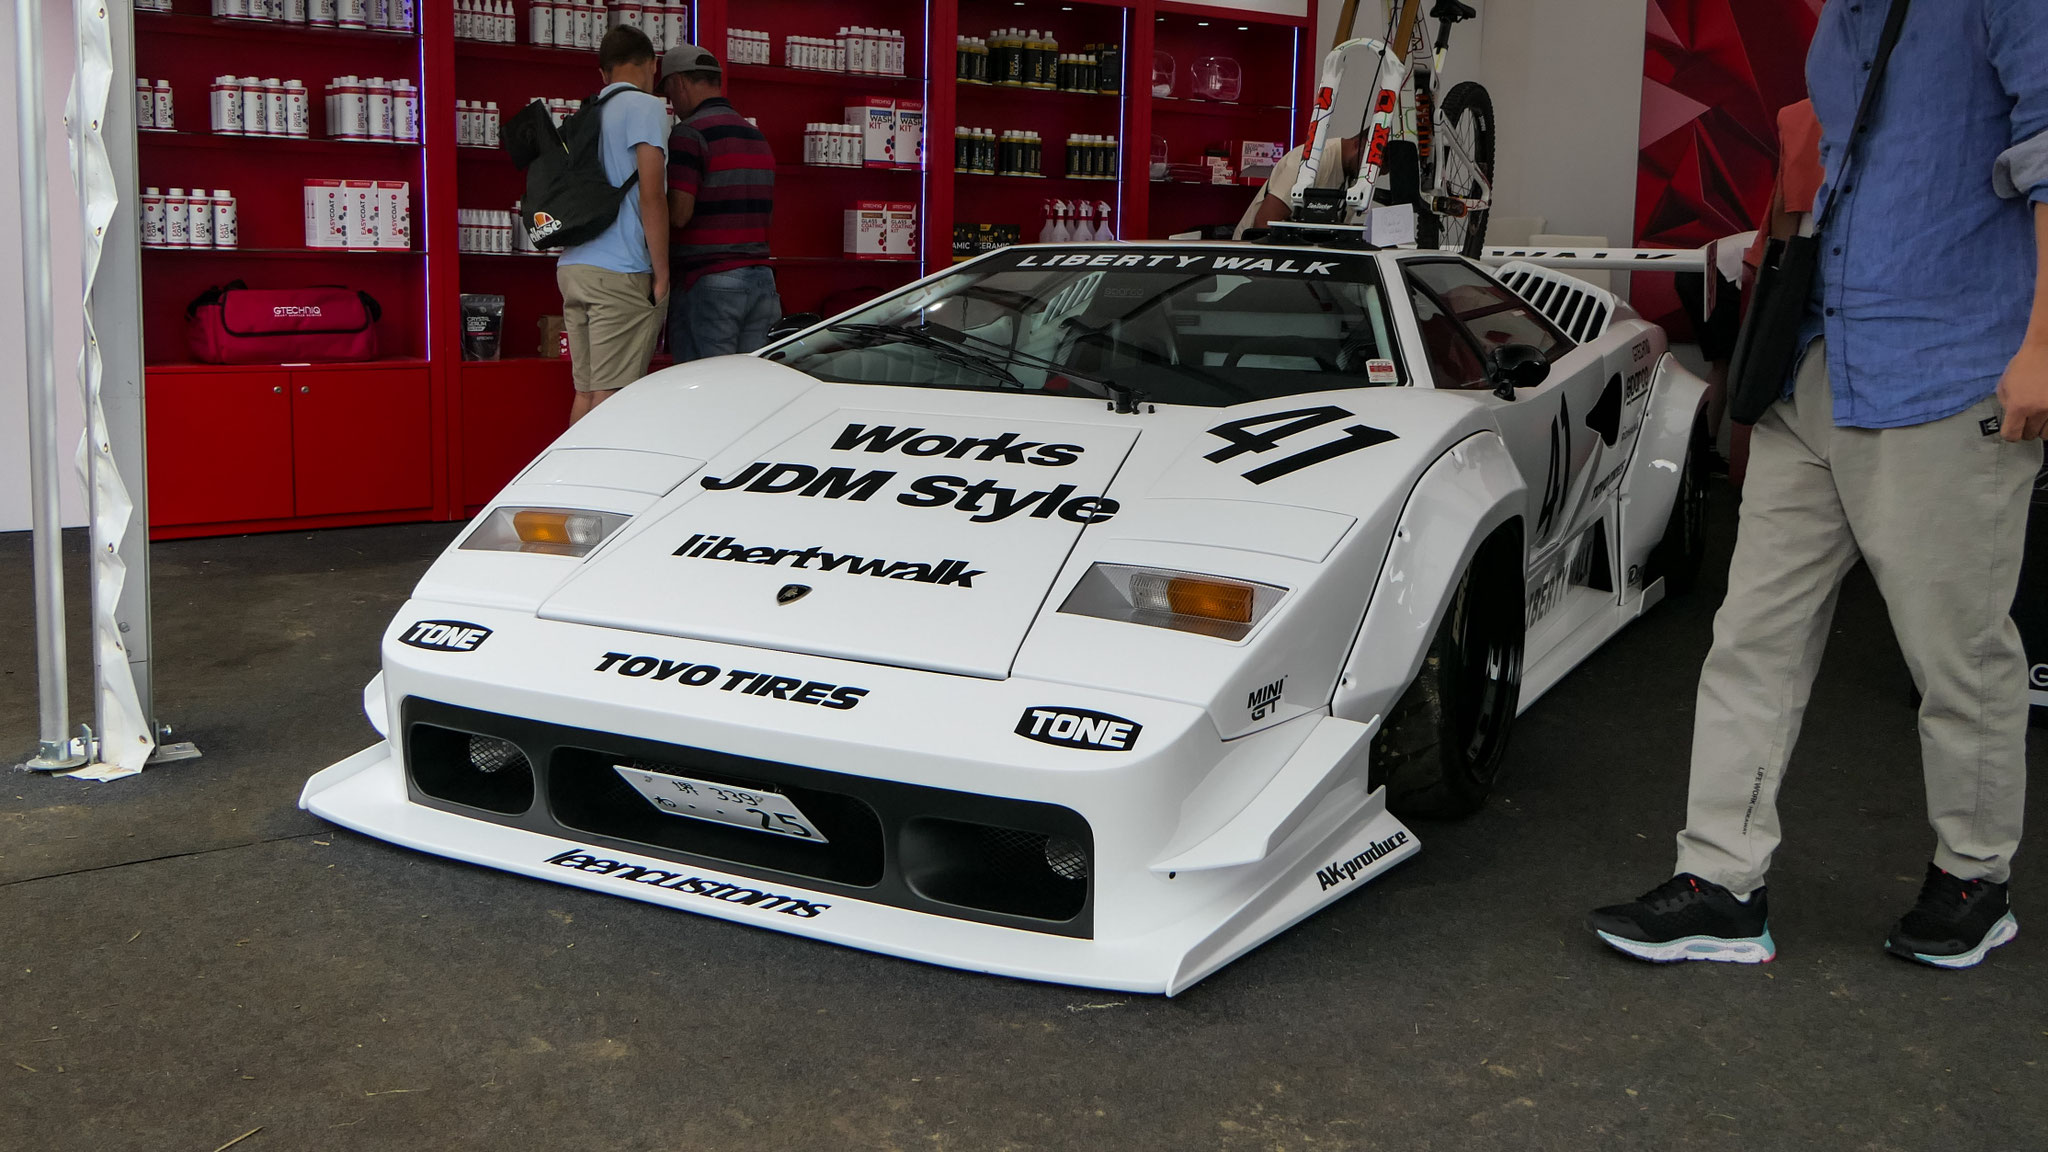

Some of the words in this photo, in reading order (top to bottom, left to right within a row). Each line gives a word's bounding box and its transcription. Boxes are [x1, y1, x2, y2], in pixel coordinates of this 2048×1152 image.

[1016, 255, 1205, 268] LIBERTY
[1212, 257, 1341, 275] WALK
[830, 424, 1085, 466] Works
[1202, 405, 1400, 485] 41
[1536, 392, 1571, 537] 41
[700, 462, 898, 501] JDM
[896, 475, 1120, 524] Style
[671, 534, 988, 588] libertywalk
[407, 622, 483, 650] TONE
[594, 652, 721, 687] TOYO
[723, 669, 870, 710] TIRES
[1247, 678, 1284, 709] MINI
[1030, 709, 1133, 748] TONE
[1251, 695, 1281, 721] GT
[708, 787, 758, 806] 339
[543, 849, 832, 918] leencustoms
